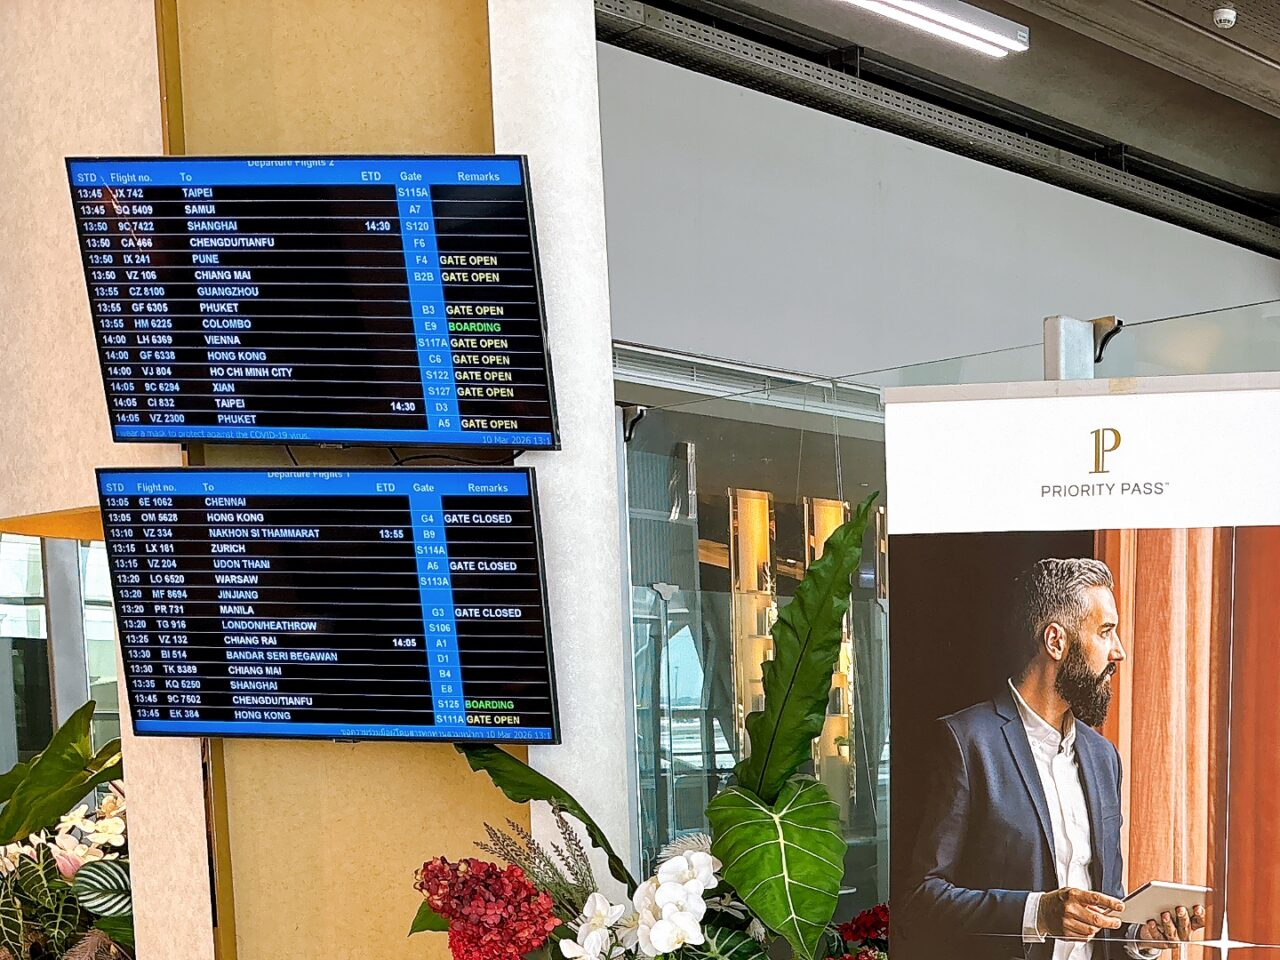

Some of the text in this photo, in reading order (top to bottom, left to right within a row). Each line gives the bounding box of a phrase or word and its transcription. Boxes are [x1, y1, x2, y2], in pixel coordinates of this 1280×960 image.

[77, 172, 96, 182] STD
[110, 172, 136, 184] Flight
[179, 172, 192, 181] To
[360, 171, 381, 180] ETD
[399, 171, 421, 180] Gate
[457, 171, 500, 180] Remarks
[91, 270, 499, 282] 13:50 VZ 106 CHIANG MAI B2B GATE OPEN
[115, 413, 517, 429] 14:05 VZ 2300 PHUKET A5 GATE OPEN
[1041, 482, 1115, 497] PRIORITY
[121, 604, 521, 617] 13:20 PR 731 MANILA G3 GATE CLOSED
[136, 709, 520, 724] 13:45 EK 384 HONG KONG S111A GATE OPEN
